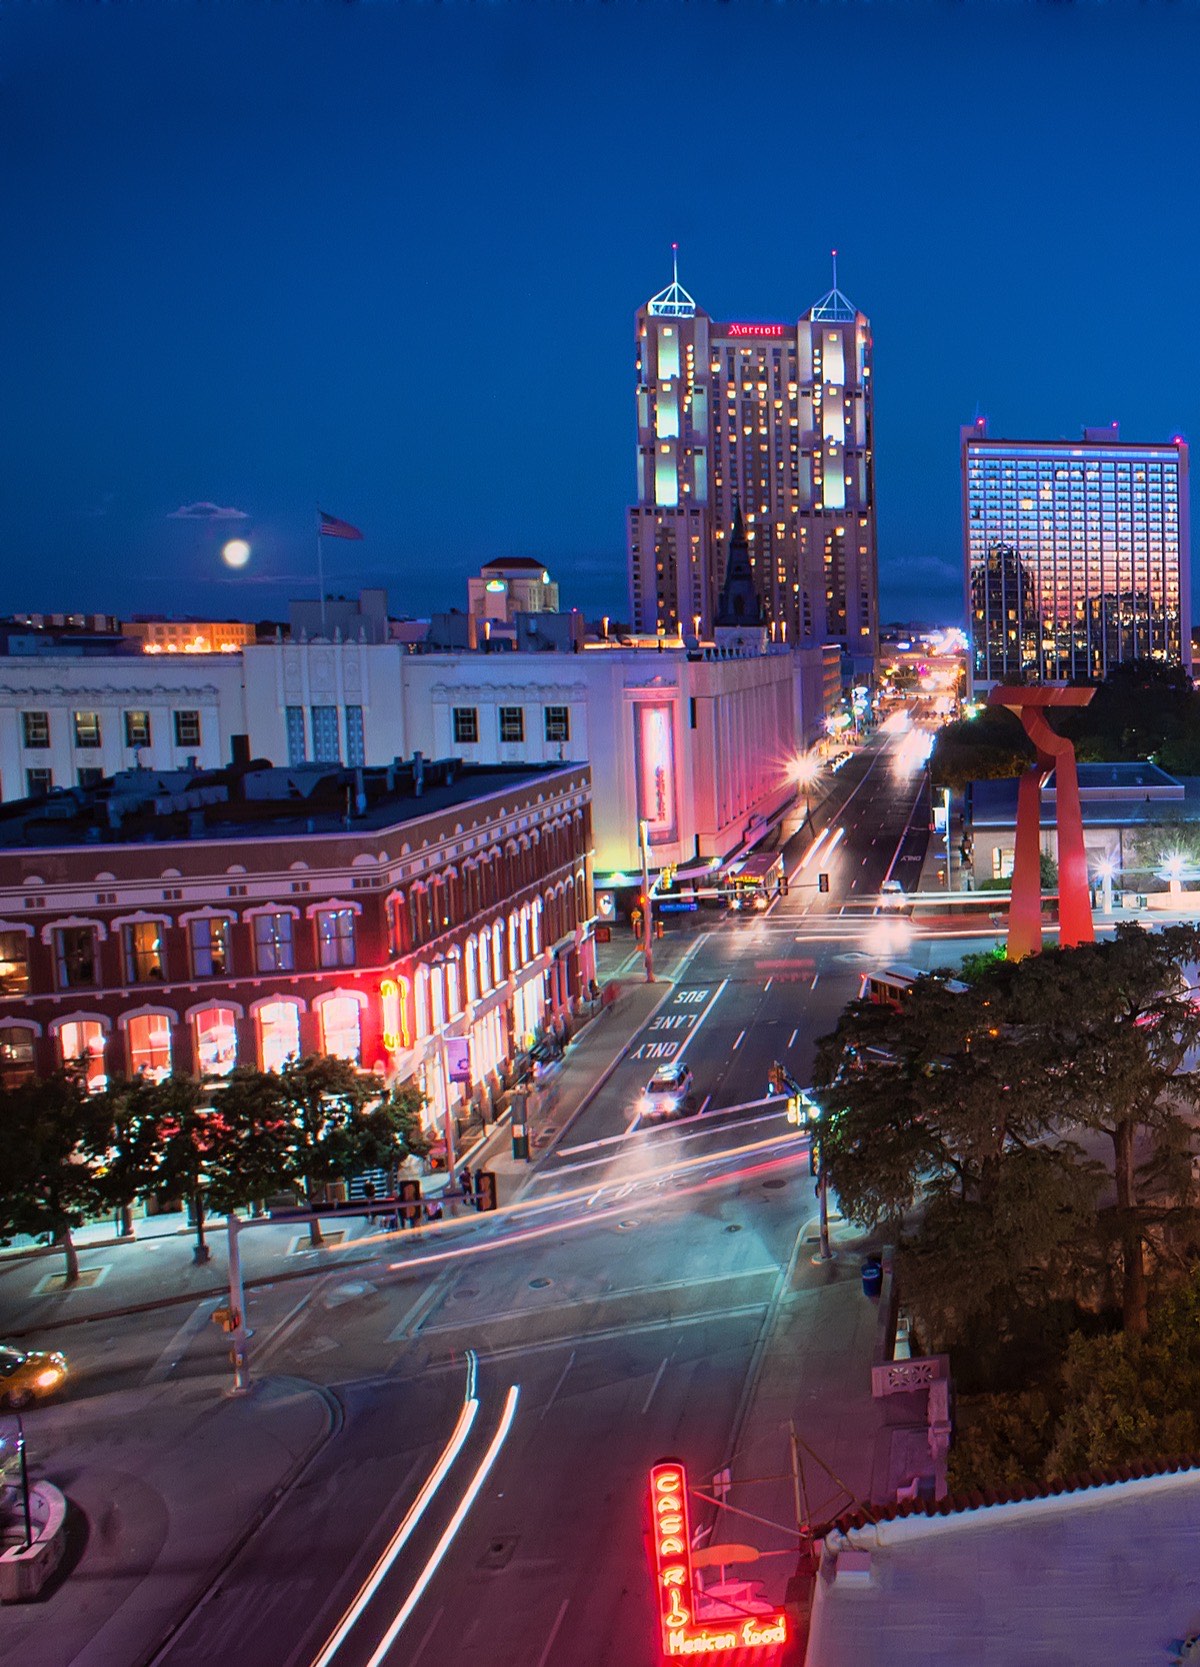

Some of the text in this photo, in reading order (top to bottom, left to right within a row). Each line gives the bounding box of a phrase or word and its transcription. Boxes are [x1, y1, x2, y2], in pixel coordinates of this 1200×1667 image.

[728, 324, 782, 335] Marriott
[673, 989, 710, 1004] BUS
[648, 1013, 698, 1031] LANE
[630, 1041, 680, 1060] ONLY
[668, 1630, 737, 1655] Mexican
